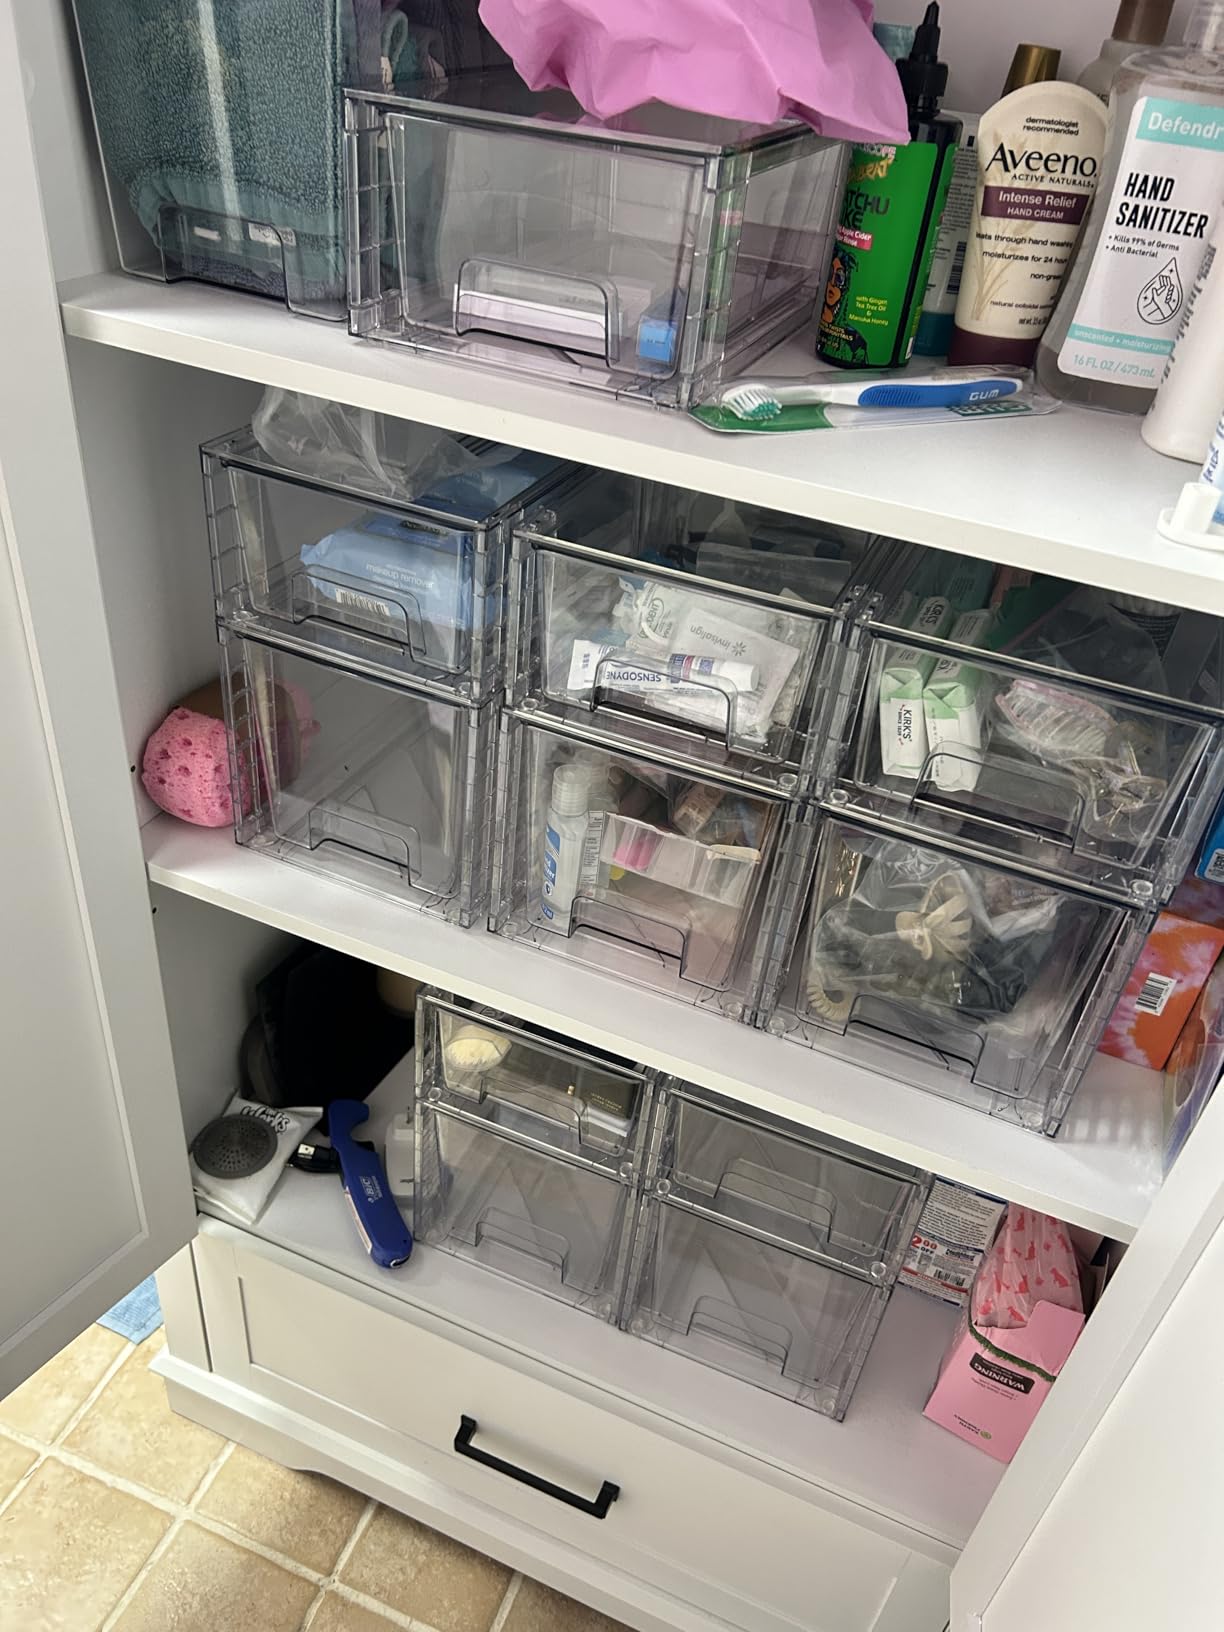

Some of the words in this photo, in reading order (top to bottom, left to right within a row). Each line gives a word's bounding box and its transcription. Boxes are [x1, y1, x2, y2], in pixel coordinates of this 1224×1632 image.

[1026, 117, 1079, 128] dermatologist
[1023, 125, 1079, 136] recommended
[1012, 173, 1045, 183] ACTIVE
[1124, 172, 1175, 202] HAND
[999, 191, 1042, 204] Intense
[1045, 194, 1077, 208] Relief
[1007, 207, 1032, 217] HAND
[1034, 209, 1064, 220] CREAM
[1115, 202, 1208, 239] SANITIZER
[994, 234, 1027, 245] through
[1028, 236, 1049, 246] hand
[1114, 235, 1130, 244] Kills
[1132, 237, 1146, 246] 99%
[1148, 239, 1155, 247] of
[1156, 240, 1180, 251] Germs
[982, 250, 1029, 262] moisturizes
[1031, 254, 1042, 263] for
[1110, 245, 1125, 254] Anti
[1126, 246, 1158, 258] Bacterial
[990, 299, 1014, 308] natural
[871, 318, 889, 326] Honey
[1074, 328, 1115, 344] unscented
[1073, 354, 1084, 366] 16
[1085, 357, 1098, 369] FL.
[1100, 360, 1114, 372] OZ
[1120, 363, 1140, 376] 473
[969, 388, 1000, 401] GUM
[690, 624, 731, 651] invisalign
[606, 669, 662, 683] SENSODYNE
[903, 709, 912, 740] KIRK'S
[920, 1246, 935, 1255] OFF
[974, 1362, 1025, 1391] WARNING
